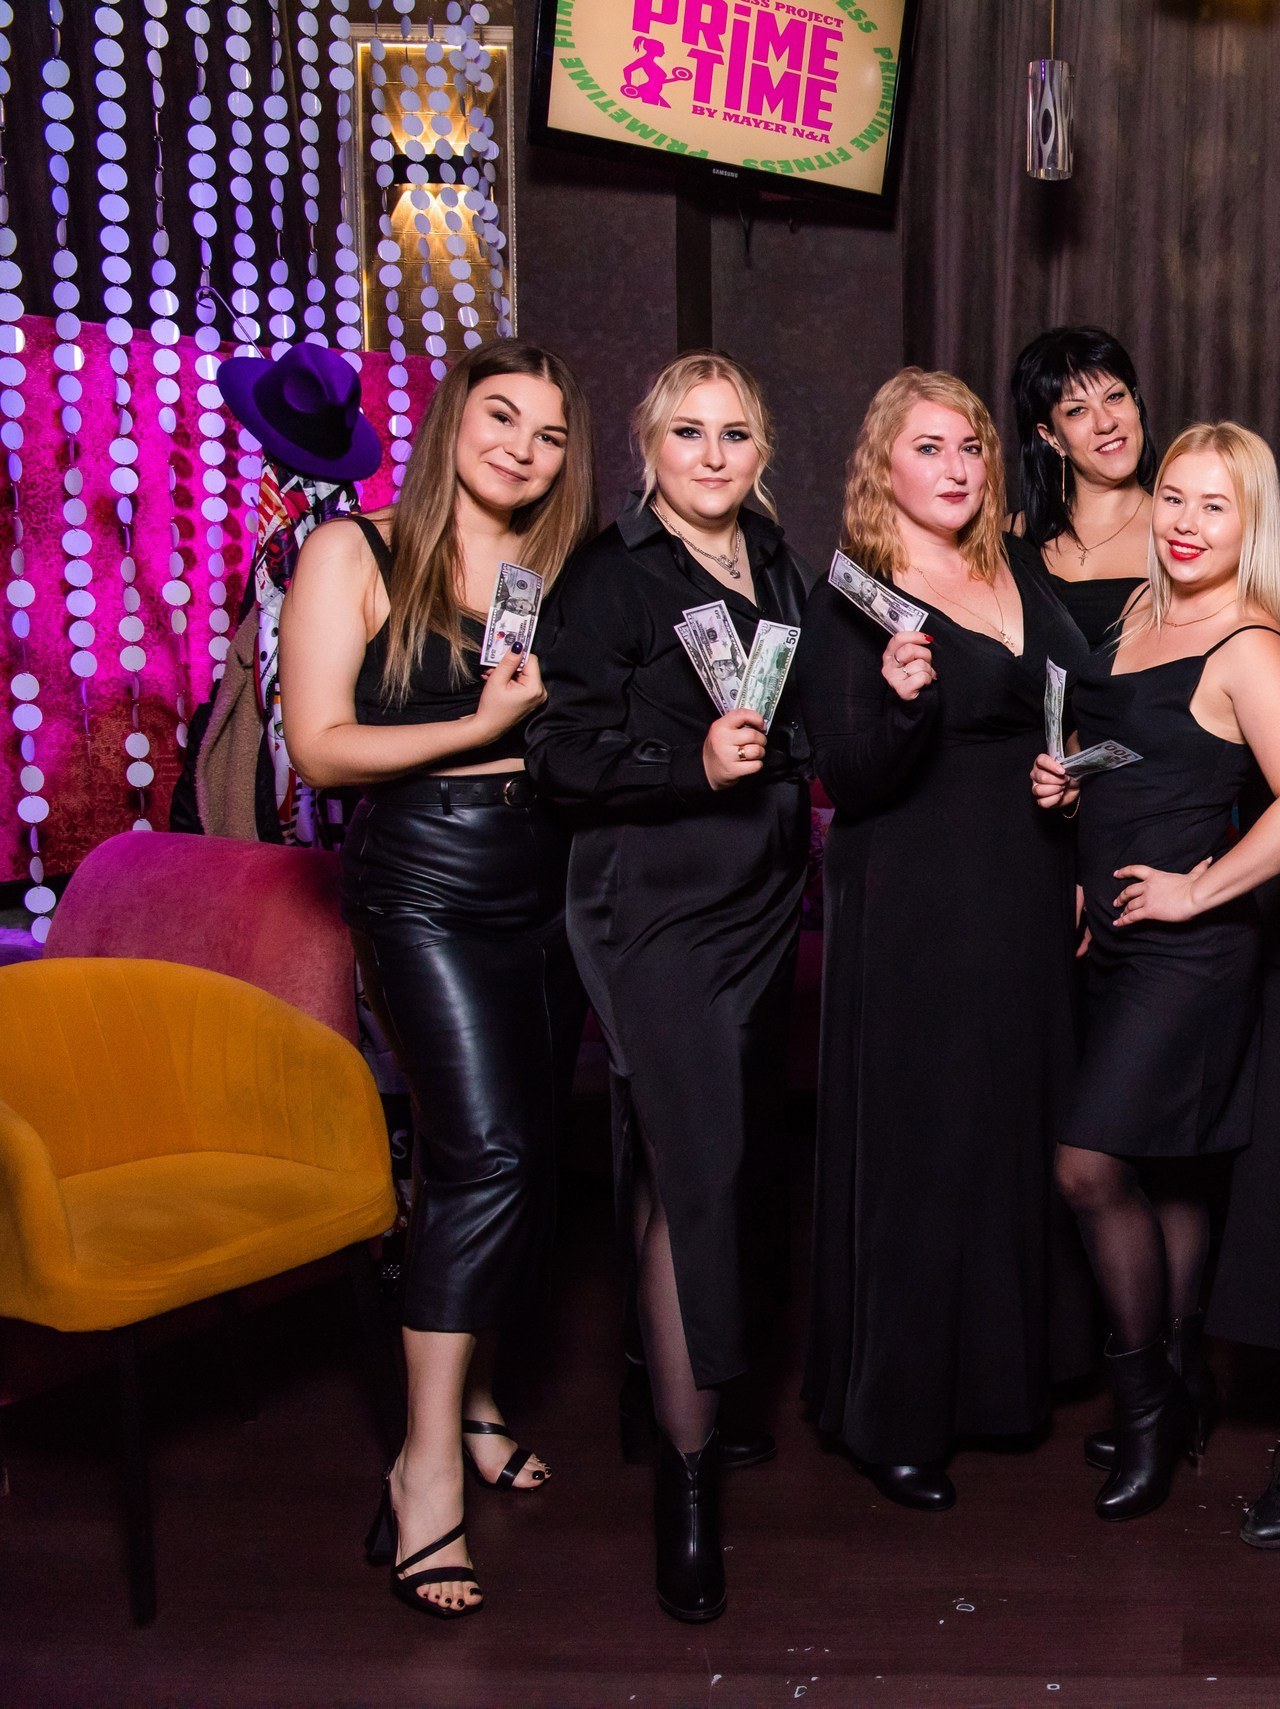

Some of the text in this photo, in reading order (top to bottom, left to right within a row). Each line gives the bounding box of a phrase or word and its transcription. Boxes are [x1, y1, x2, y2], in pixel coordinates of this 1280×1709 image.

[774, 1, 844, 28] PROJECT
[687, 47, 838, 132] TIME
[692, 104, 831, 144] BY MAYER N&A
[712, 168, 738, 178] SAMSUNG
[742, 147, 853, 175] FITNESS
[786, 629, 799, 646] 50
